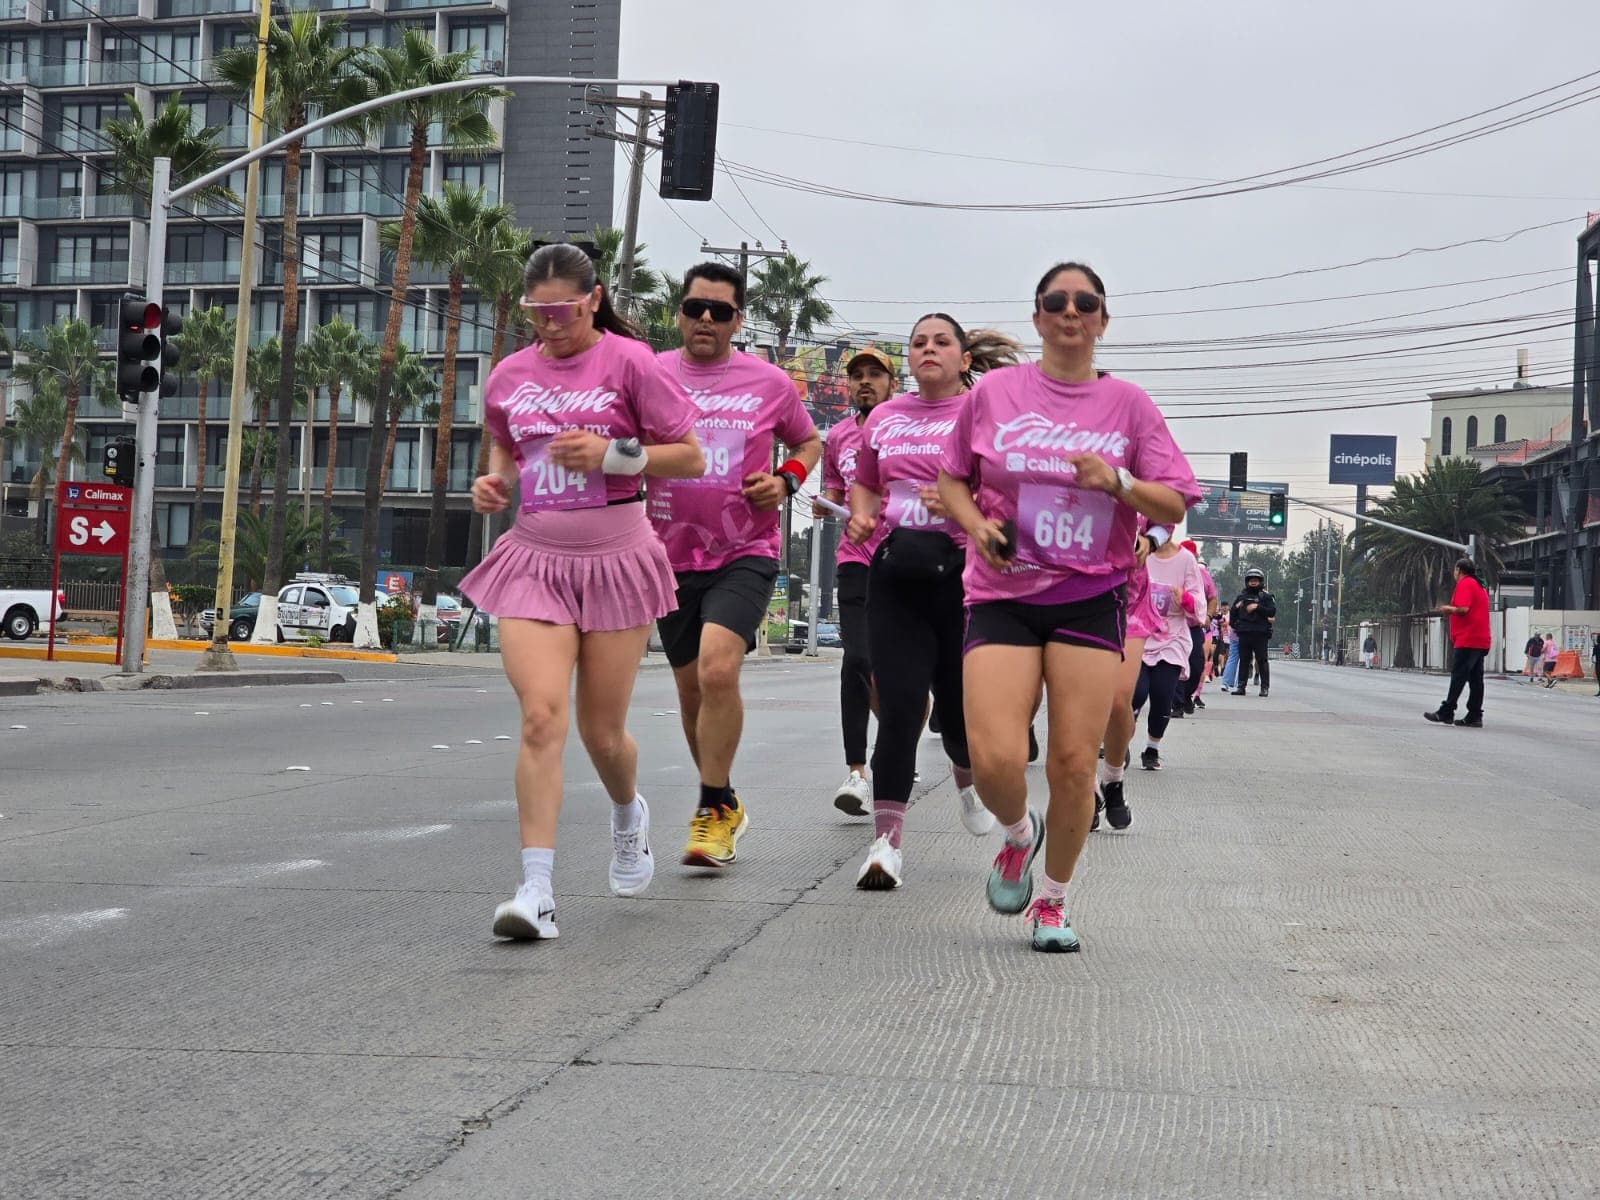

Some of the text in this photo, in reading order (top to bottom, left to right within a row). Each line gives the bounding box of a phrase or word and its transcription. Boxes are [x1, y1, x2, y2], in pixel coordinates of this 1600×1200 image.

[993, 411, 1130, 458] Caliente
[1334, 452, 1392, 467] cinépolis
[532, 460, 587, 495] 204
[85, 489, 123, 501] Calimax
[69, 516, 89, 545] S
[1034, 510, 1094, 551] 664
[389, 576, 400, 590] E
